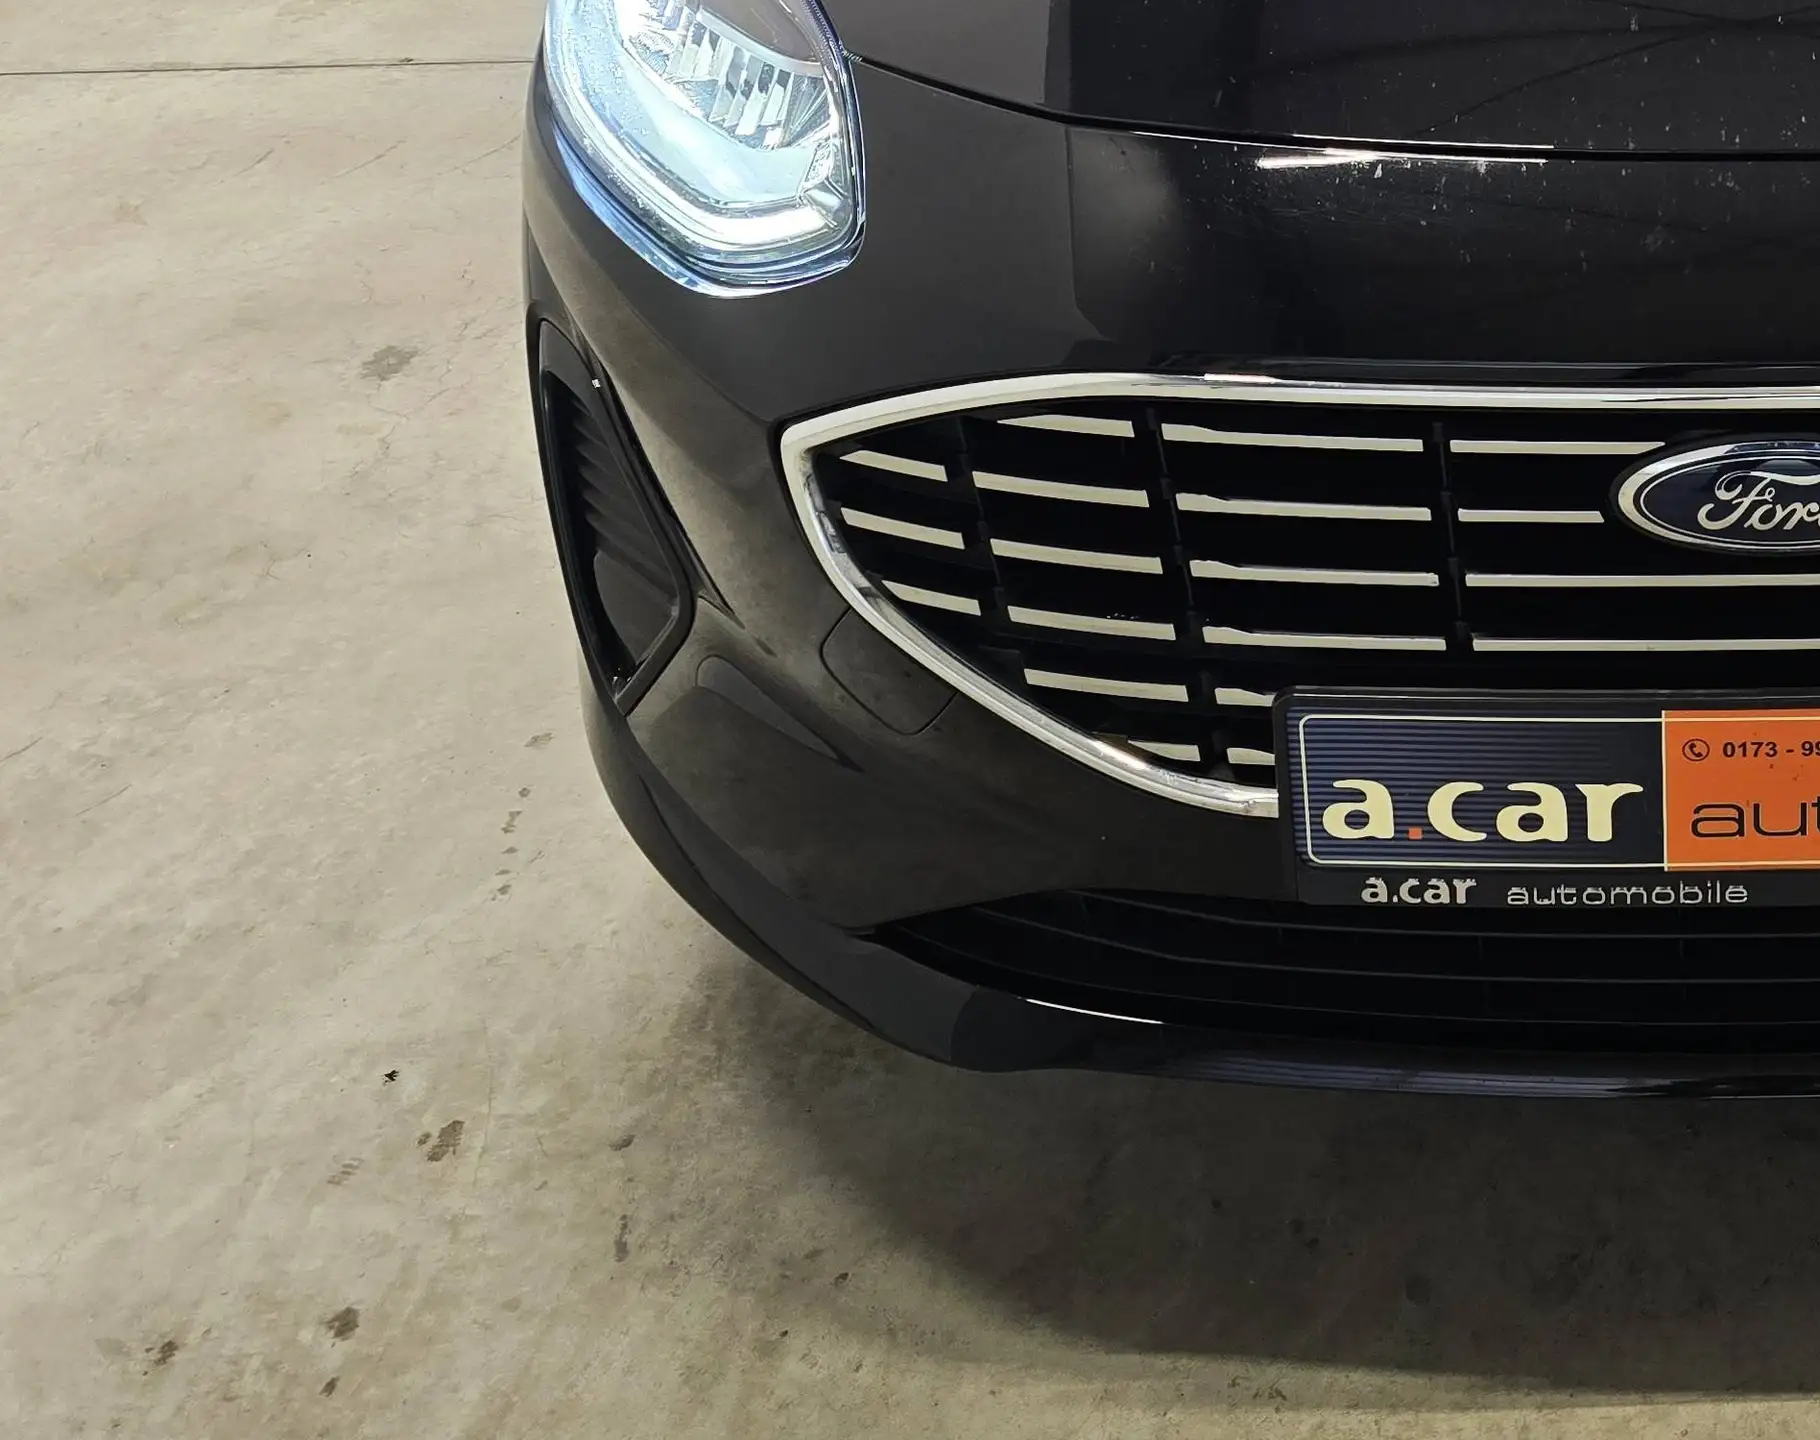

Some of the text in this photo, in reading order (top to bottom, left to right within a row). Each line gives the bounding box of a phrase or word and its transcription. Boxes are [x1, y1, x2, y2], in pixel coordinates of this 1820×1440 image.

[1722, 741, 1778, 758] 0173
[1322, 778, 1644, 842] a.car
[1361, 876, 1749, 905] a.car automobile
